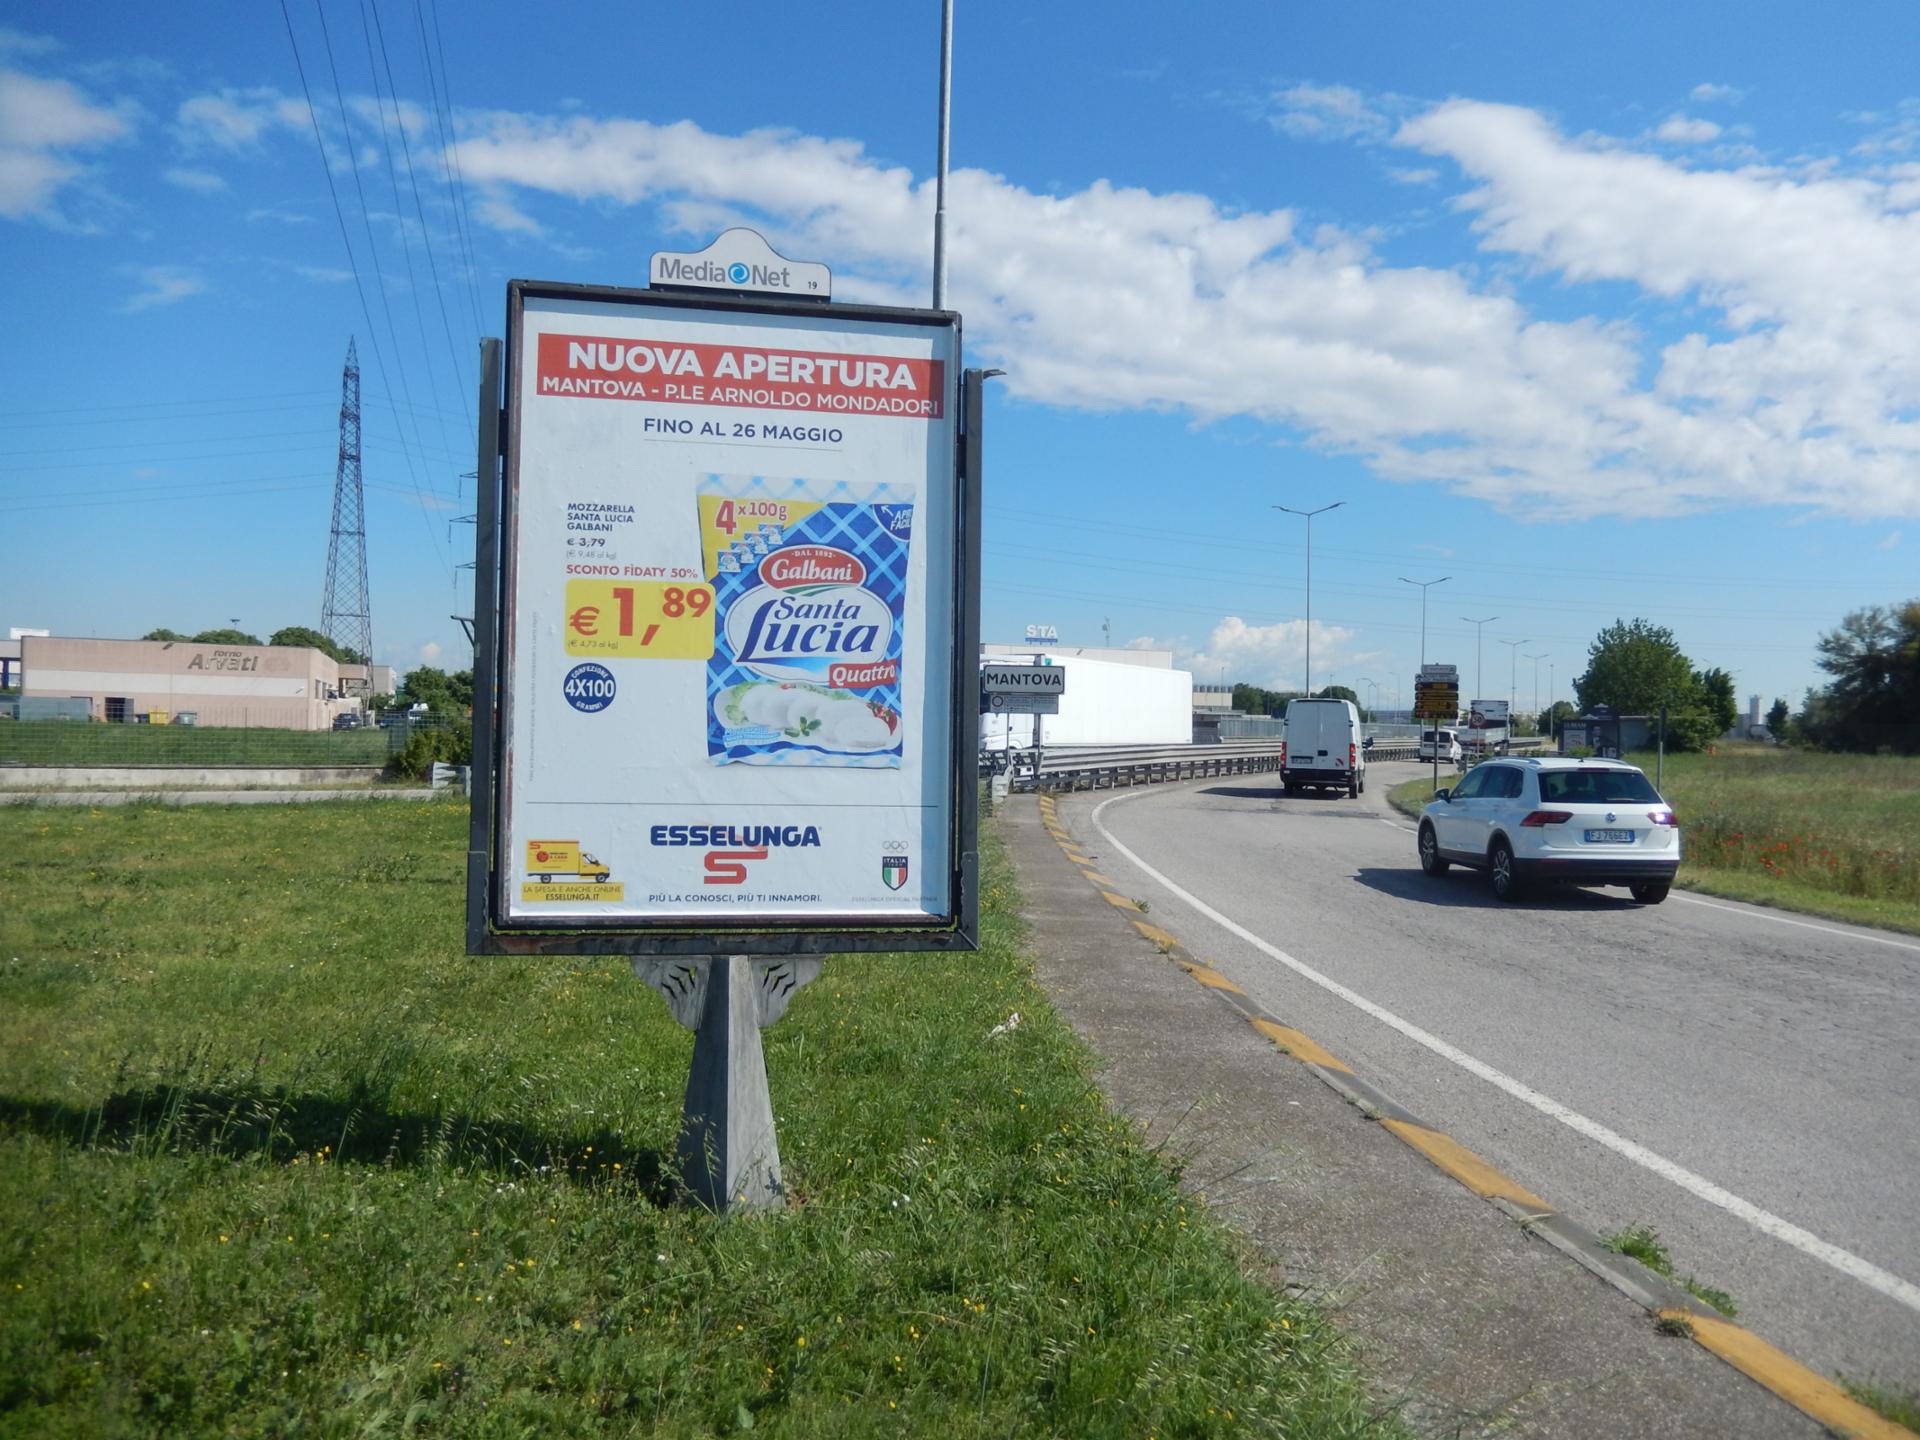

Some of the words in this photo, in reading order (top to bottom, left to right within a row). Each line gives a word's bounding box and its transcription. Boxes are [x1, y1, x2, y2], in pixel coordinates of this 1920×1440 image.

[659, 257, 725, 283] Media
[752, 264, 790, 287] Net
[808, 281, 817, 290] 19
[569, 342, 704, 377] NUOVA
[713, 352, 916, 390] APERTURA
[543, 377, 646, 397] MANTOVA
[665, 384, 704, 400] P.LE
[710, 387, 810, 407] ARNOLDO
[817, 393, 938, 415] MONDADORI
[644, 418, 693, 434] FINO
[700, 421, 726, 436] AL
[732, 423, 756, 437] 26
[763, 425, 843, 443] MAGGIO
[567, 503, 635, 513] MOZZARELLA
[567, 513, 600, 521] SANTA
[604, 514, 634, 523] LUCIA
[567, 522, 612, 532] GALBANI
[567, 537, 575, 546] €
[578, 538, 606, 547] 3,79
[566, 565, 619, 576] SCONTO
[671, 568, 698, 578] 50%
[770, 559, 853, 581] Galbani
[774, 596, 861, 620] Santa
[569, 606, 600, 636] €
[736, 599, 879, 662] Lucia
[1026, 624, 1057, 637] STA
[188, 653, 258, 671] Arvati
[832, 664, 895, 685] Quattro
[987, 673, 1061, 686] MANTOVA
[565, 679, 615, 697] 4X100
[650, 825, 821, 847] ESSELUNGA
[545, 893, 600, 901] ESSELUNGA.IT
[650, 892, 665, 902] PIÙ
[669, 894, 681, 902] LA
[685, 894, 734, 903] CONOSCI,
[738, 893, 753, 902] PIÙ
[757, 894, 766, 902] TI
[769, 894, 822, 902] INNAMORI.
